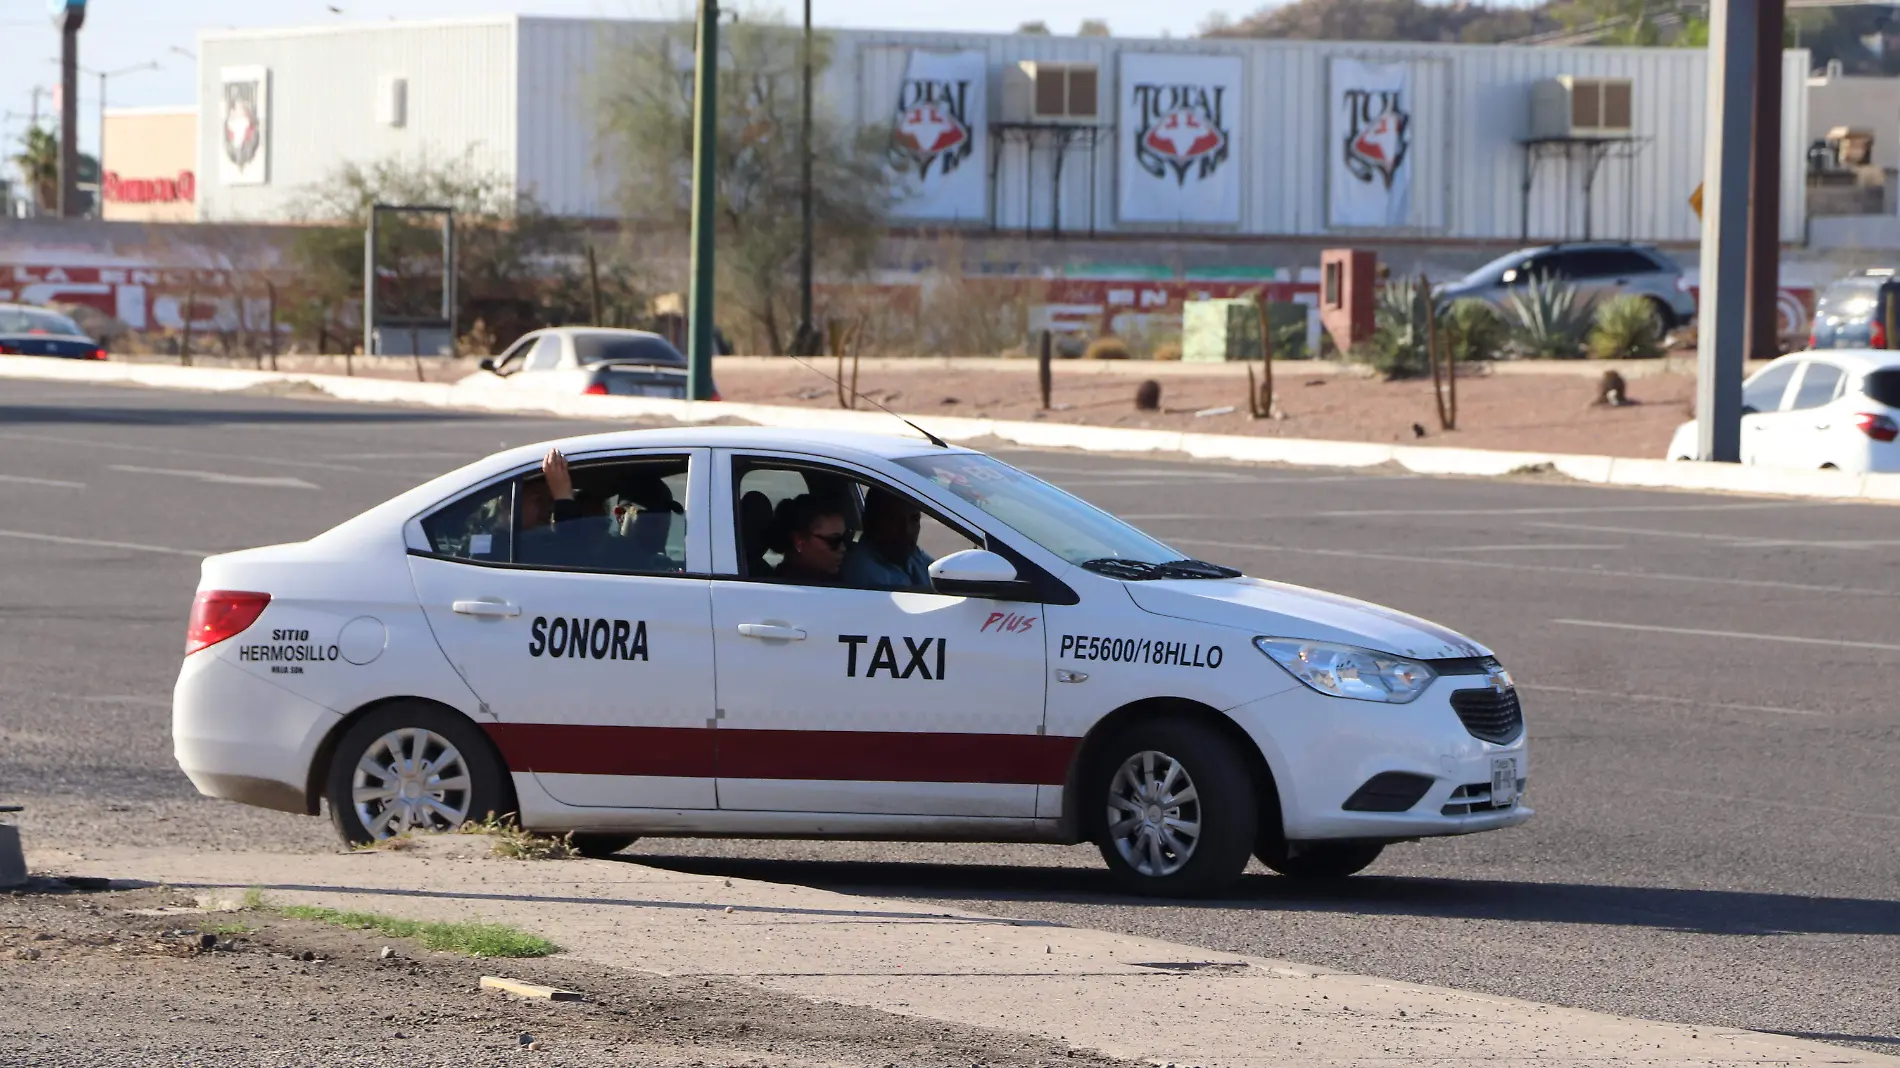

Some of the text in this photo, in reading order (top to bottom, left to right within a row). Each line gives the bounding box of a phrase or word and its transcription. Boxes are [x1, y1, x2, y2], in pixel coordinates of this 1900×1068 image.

[239, 645, 339, 661] HERMOSILLO
[272, 629, 309, 642] SITIO
[529, 616, 649, 662] SONORA
[1060, 634, 1223, 669] PE5600/18HLLO
[838, 634, 947, 681] TAXI
